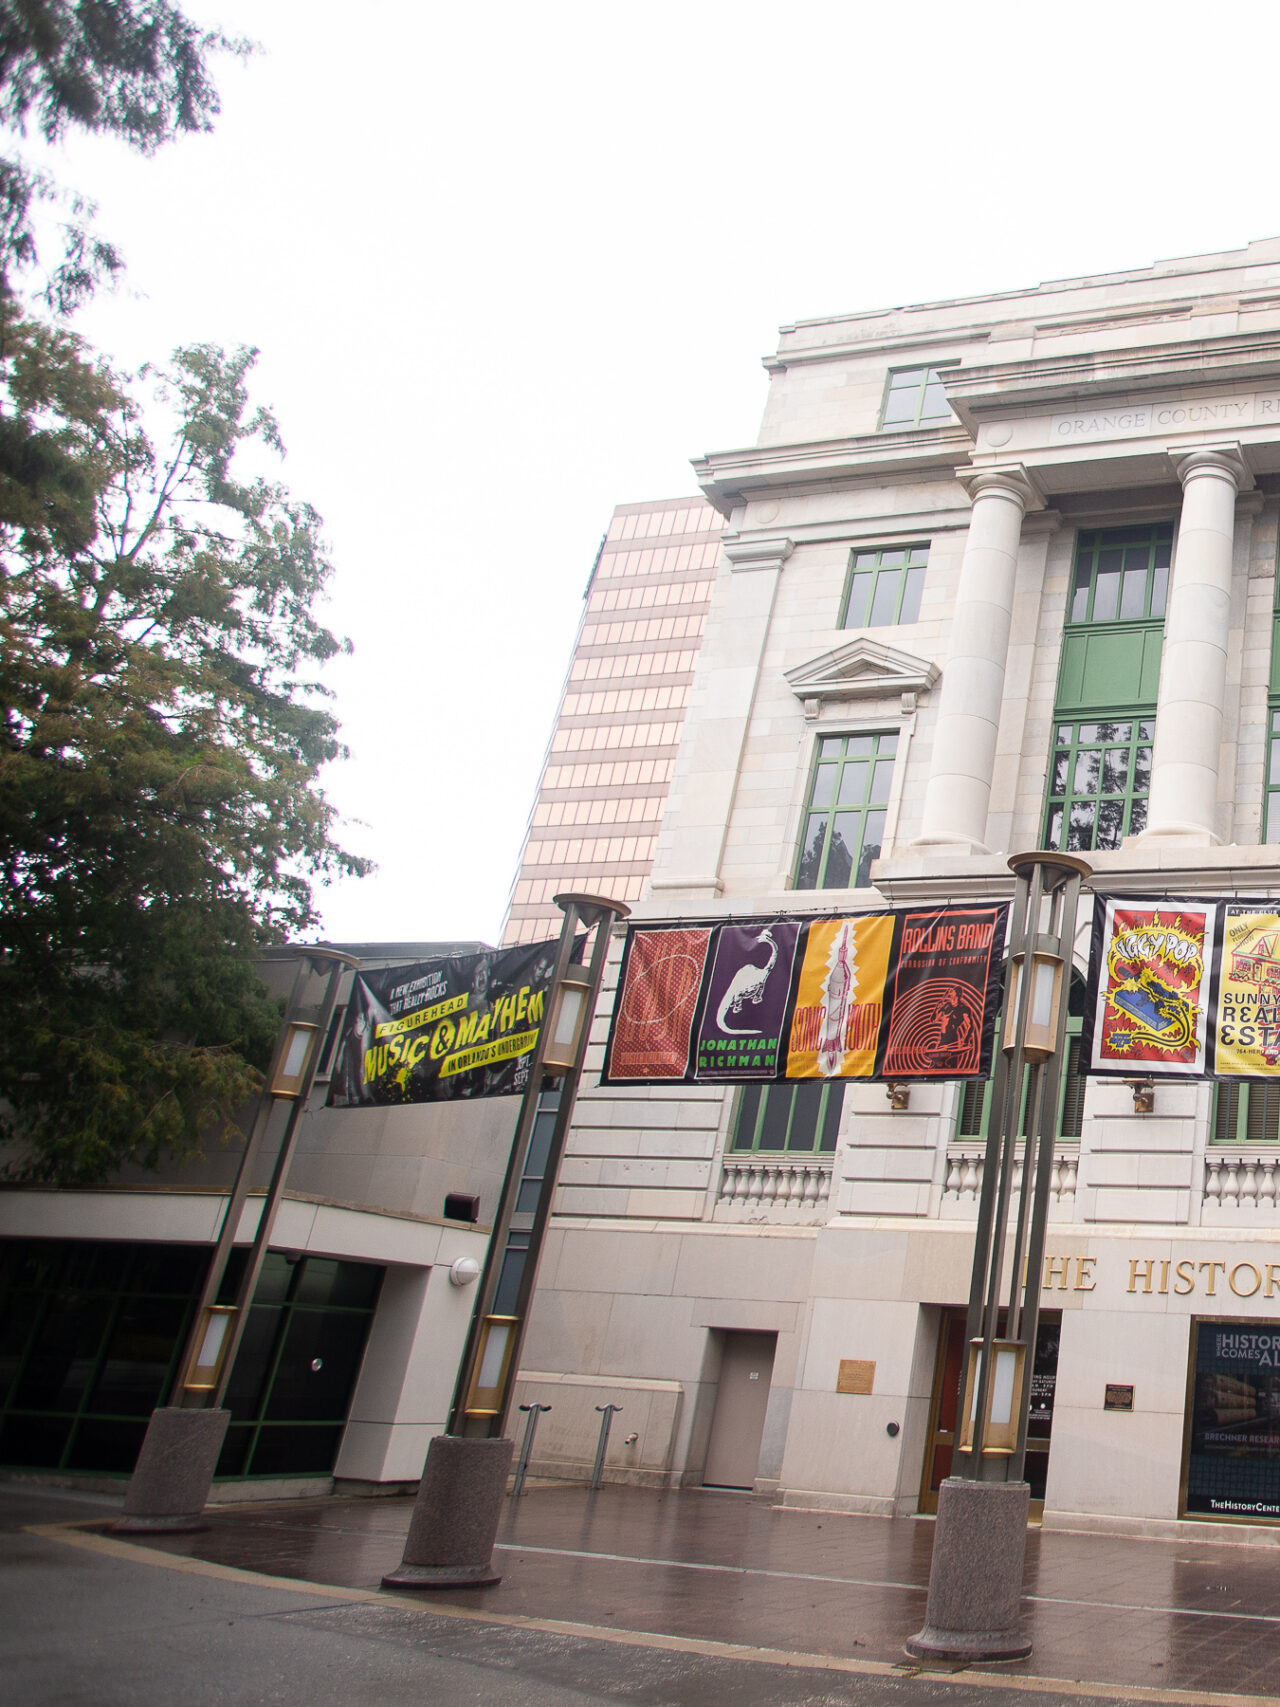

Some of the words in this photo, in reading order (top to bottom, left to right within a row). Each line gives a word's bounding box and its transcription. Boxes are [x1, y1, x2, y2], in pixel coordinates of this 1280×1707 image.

[1057, 412, 1146, 436] ORANGE
[1157, 401, 1247, 427] COUNTY
[903, 925, 956, 954] ROLLINS
[957, 923, 994, 951] BAND
[1229, 922, 1249, 937] ONLY
[1115, 933, 1166, 959] IGGY
[1165, 935, 1198, 963] POP
[395, 982, 410, 998] NEW
[424, 980, 448, 1002] ROCKS
[379, 997, 464, 1033] FIGUREHEAD
[363, 1035, 432, 1085] MUSIC
[436, 1024, 451, 1054] &
[454, 985, 545, 1050] MAYHEM
[701, 1037, 778, 1052] JONATHAN
[448, 1059, 456, 1072] IN
[458, 1045, 497, 1069] ORLANDO'S
[699, 1054, 776, 1068] RICHMAN
[1022, 1255, 1098, 1291] HE
[1221, 1349, 1261, 1359] COMES
